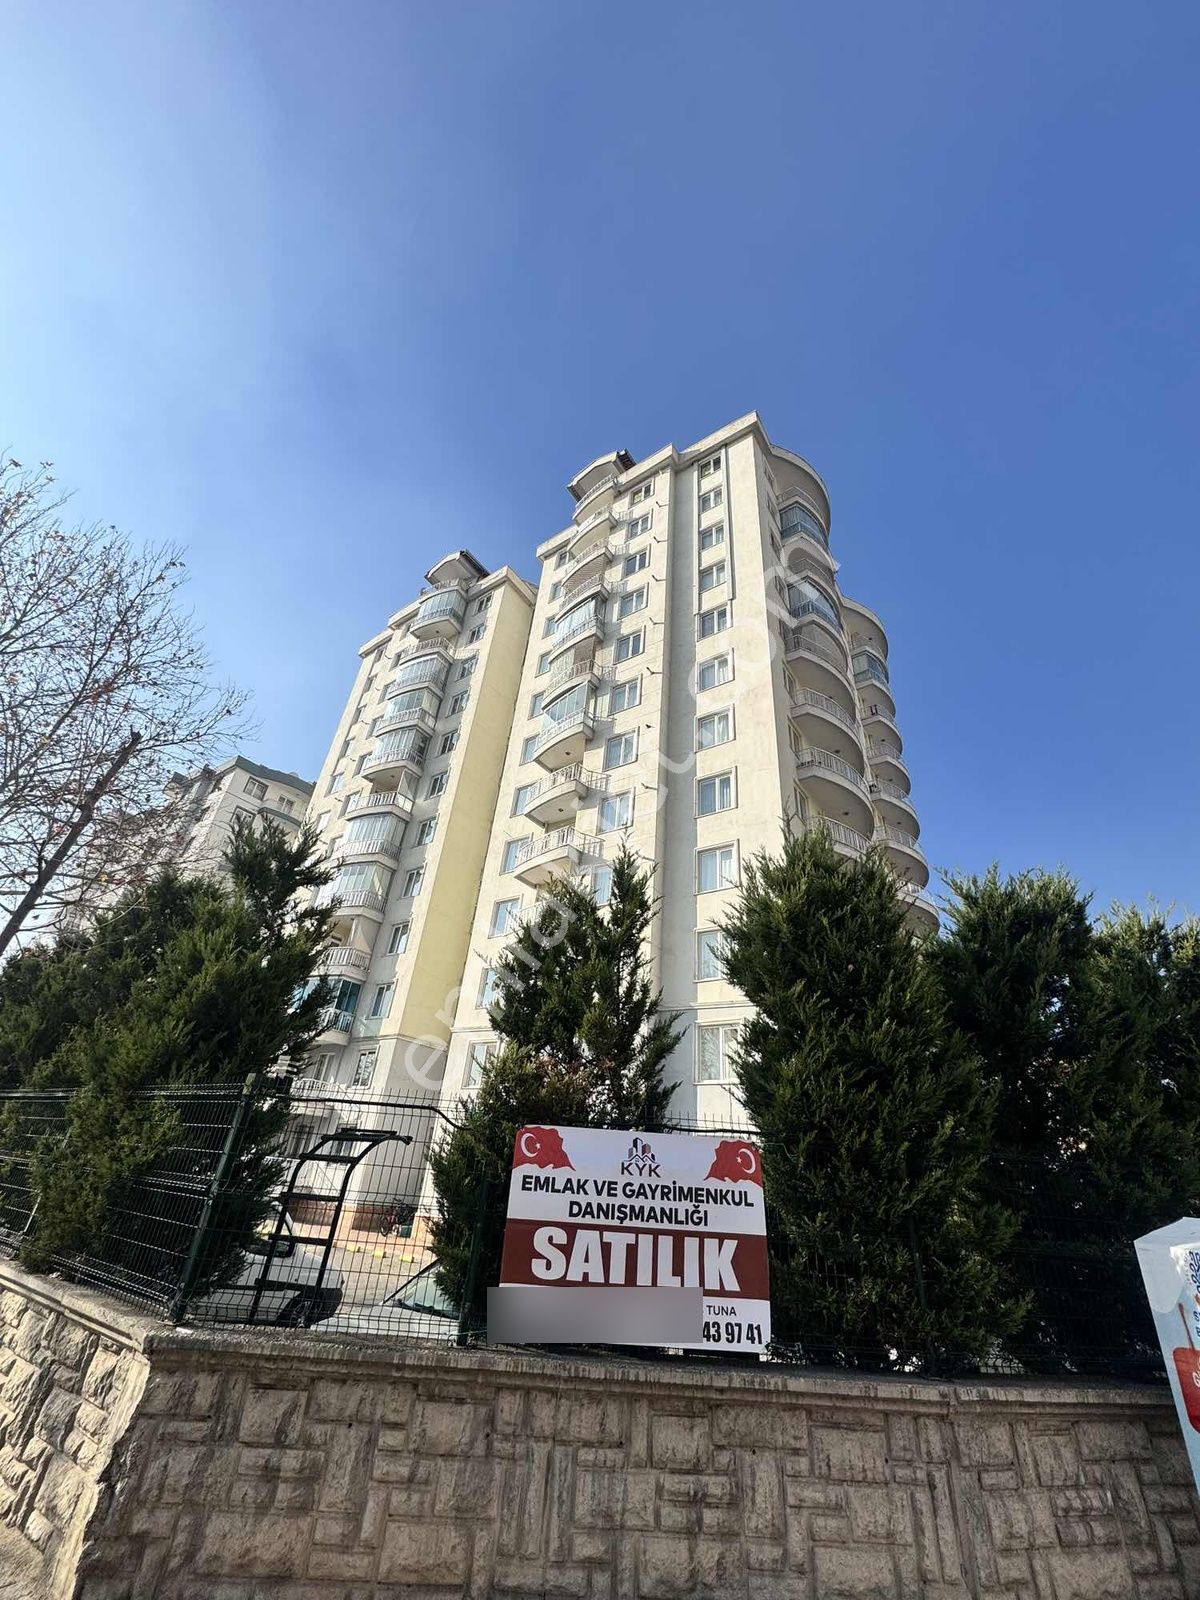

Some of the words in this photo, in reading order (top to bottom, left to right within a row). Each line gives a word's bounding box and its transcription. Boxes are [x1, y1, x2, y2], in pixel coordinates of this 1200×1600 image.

[620, 1162, 661, 1178] KYK
[521, 1175, 589, 1196] EMLAK
[593, 1180, 618, 1198] VE
[622, 1180, 754, 1208] GAYRİMENKUL
[568, 1200, 708, 1227] DANIŞMANLIĞI
[531, 1226, 741, 1292] SATILIK
[706, 1305, 737, 1317] TUNA
[725, 1322, 742, 1344] 97
[746, 1323, 762, 1345] 41
